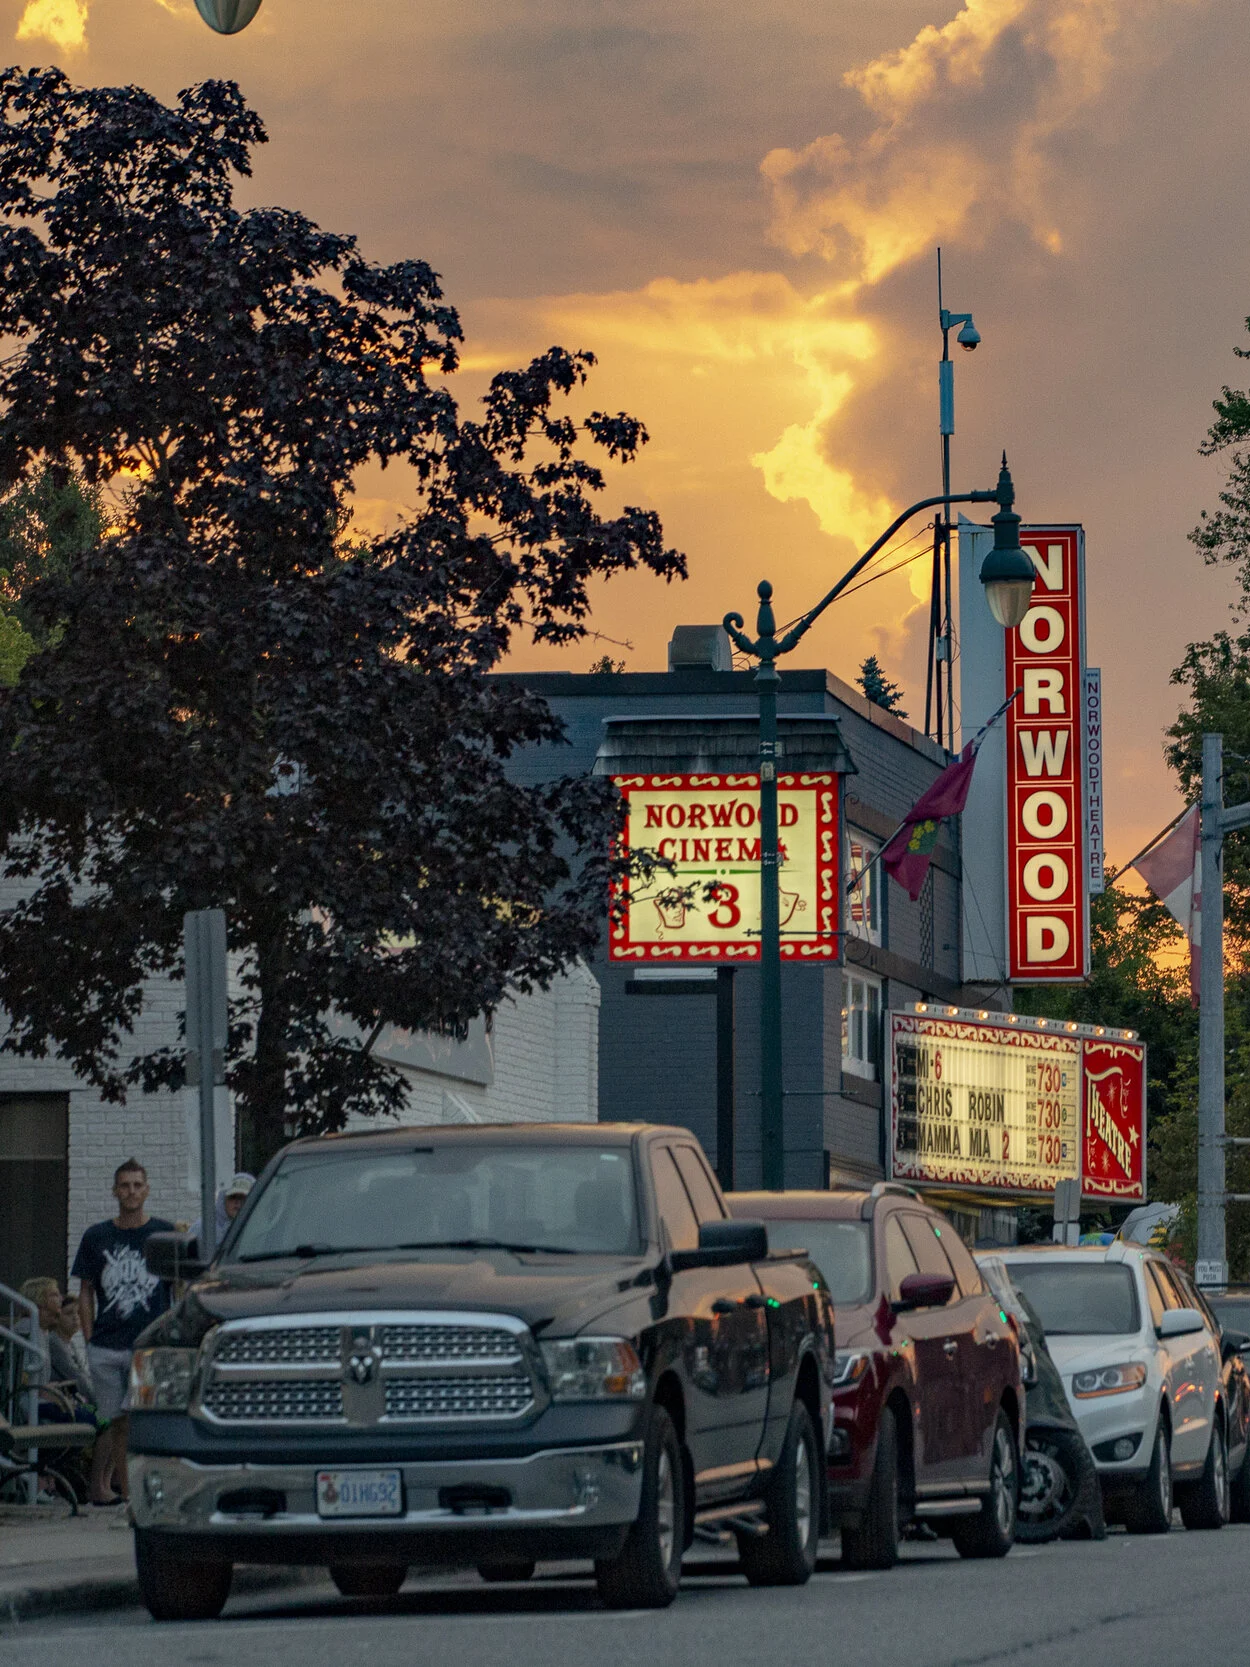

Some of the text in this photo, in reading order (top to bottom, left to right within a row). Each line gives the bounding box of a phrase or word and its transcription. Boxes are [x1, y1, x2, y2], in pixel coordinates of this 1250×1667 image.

[1019, 545, 1070, 963] NORWOOD
[643, 798, 799, 830] NORWOD
[707, 882, 741, 929] 3
[917, 1048, 942, 1080] MI-6
[1037, 1062, 1061, 1093] 730
[917, 1084, 1005, 1123] CHRIS ROBIN
[1037, 1099, 1061, 1129] 730
[1085, 1066, 1132, 1179] THEATRE
[917, 1121, 1010, 1160] MAMMA MIA 2
[1038, 1134, 1061, 1165] 730
